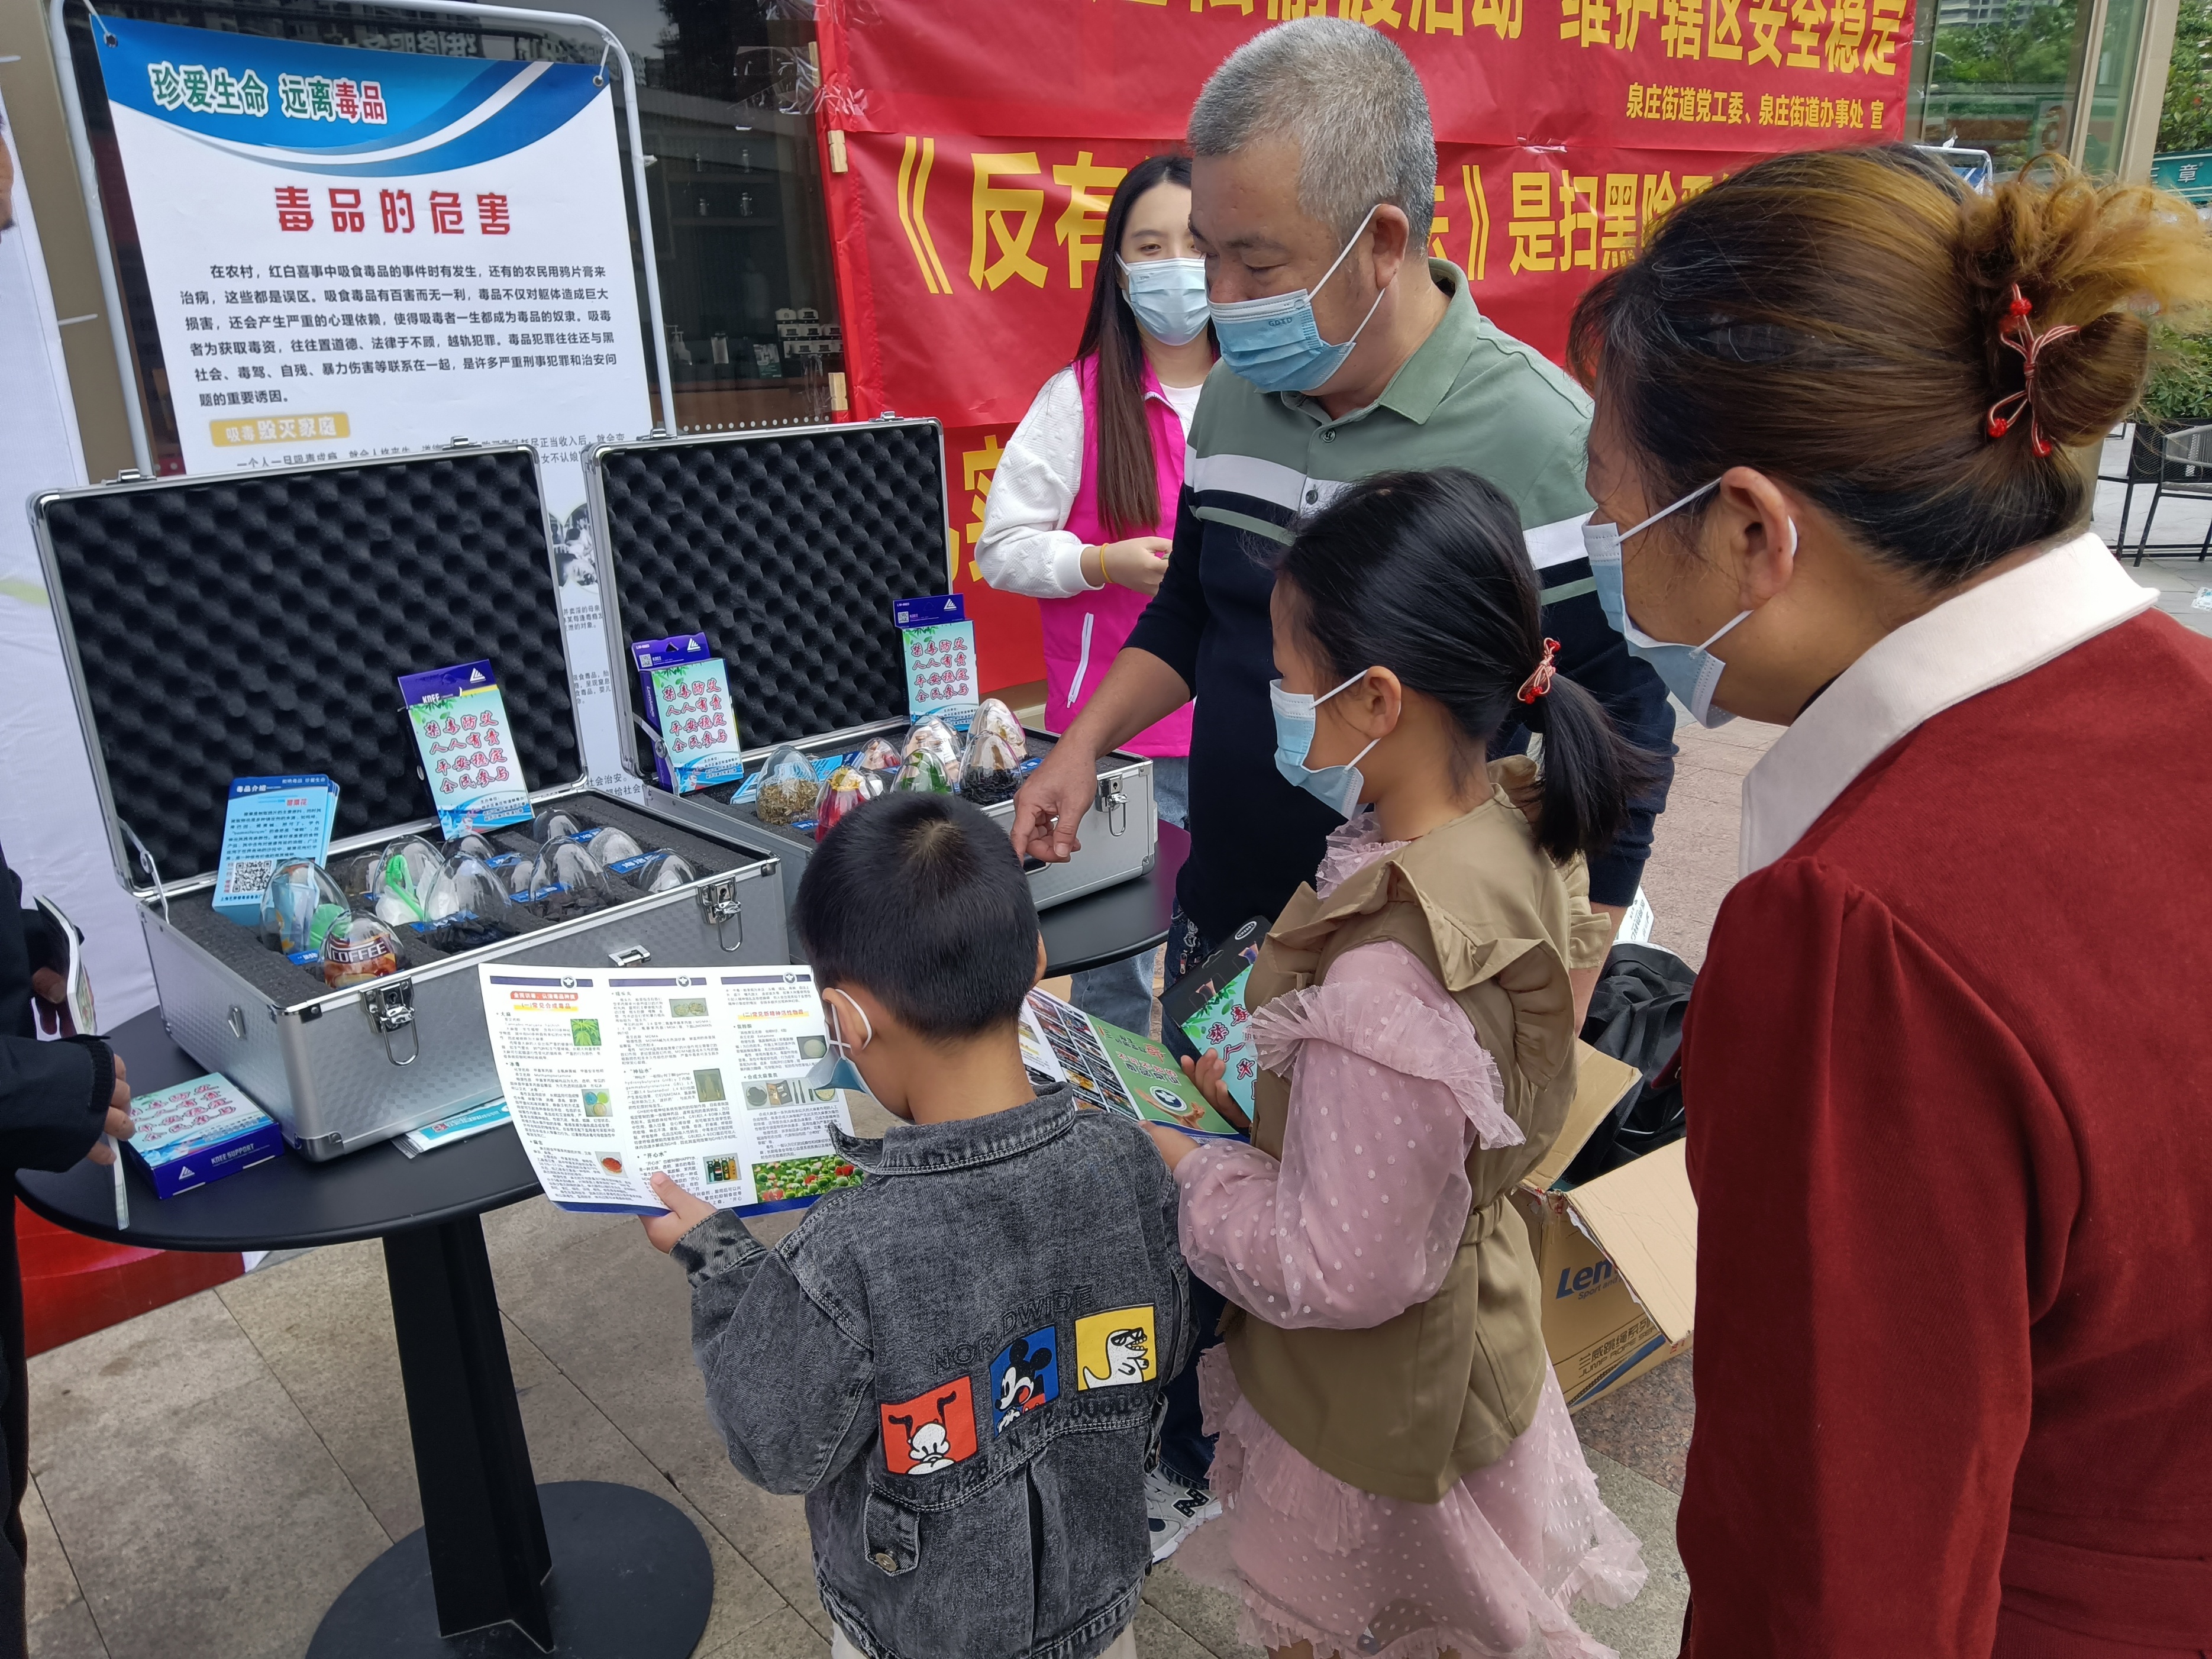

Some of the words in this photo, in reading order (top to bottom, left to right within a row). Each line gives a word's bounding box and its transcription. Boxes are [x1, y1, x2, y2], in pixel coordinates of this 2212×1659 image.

[148, 62, 268, 117] 珍爱生命
[279, 73, 387, 124] 远离毒品
[1626, 82, 1864, 128] 泉庄街道党工委、泉庄街道办事处
[1871, 99, 1884, 130] 宣
[275, 186, 510, 235] 毒品的危害
[210, 264, 606, 279] 在农村，红白喜事中吸食毒品的事件时有发生，还有的农民用鸦片膏来
[180, 288, 608, 305] 治病，这些都是误区。吸食毒品有百害而无一利，毒品不仅对躯体造成巨大
[185, 310, 611, 331] 损害，还会产生严重的心理依赖，使得吸毒者一生都成为毒品的奴隶。吸毒
[190, 332, 614, 356] 者为获取毒资，往往置道德、法律于不顾，越轨犯罪。毒品犯罪往往还与黑
[195, 353, 617, 382] 社会、毒驾、自残、暴力伤害等联系在一起，是许多严重刑事犯罪和治安问
[199, 389, 289, 407] 题的重要诱因。
[225, 417, 337, 443] 吸毒毁灭家庭
[911, 637, 967, 657] 禁毒防艾
[912, 652, 967, 670] 人人有责
[662, 677, 721, 701] 禁毒防艾
[915, 669, 969, 688] 平安稳定
[916, 683, 969, 702] 全民参与
[666, 694, 722, 716] 人人有责
[424, 710, 499, 738] 禁毒防艾
[670, 712, 726, 736] 平安稳定
[430, 728, 500, 754] 人人有责
[672, 730, 728, 753] 全民参与
[435, 748, 507, 776] 平安稳定
[440, 767, 509, 794] 全民参与
[211, 1154, 227, 1165] KNEE
[227, 1143, 254, 1158] SUPPORT
[1578, 1284, 1601, 1300] Sport
[1602, 1278, 1617, 1289] and
[1579, 1355, 1608, 1378] JUMP
[1610, 1340, 1636, 1359] ROPE
